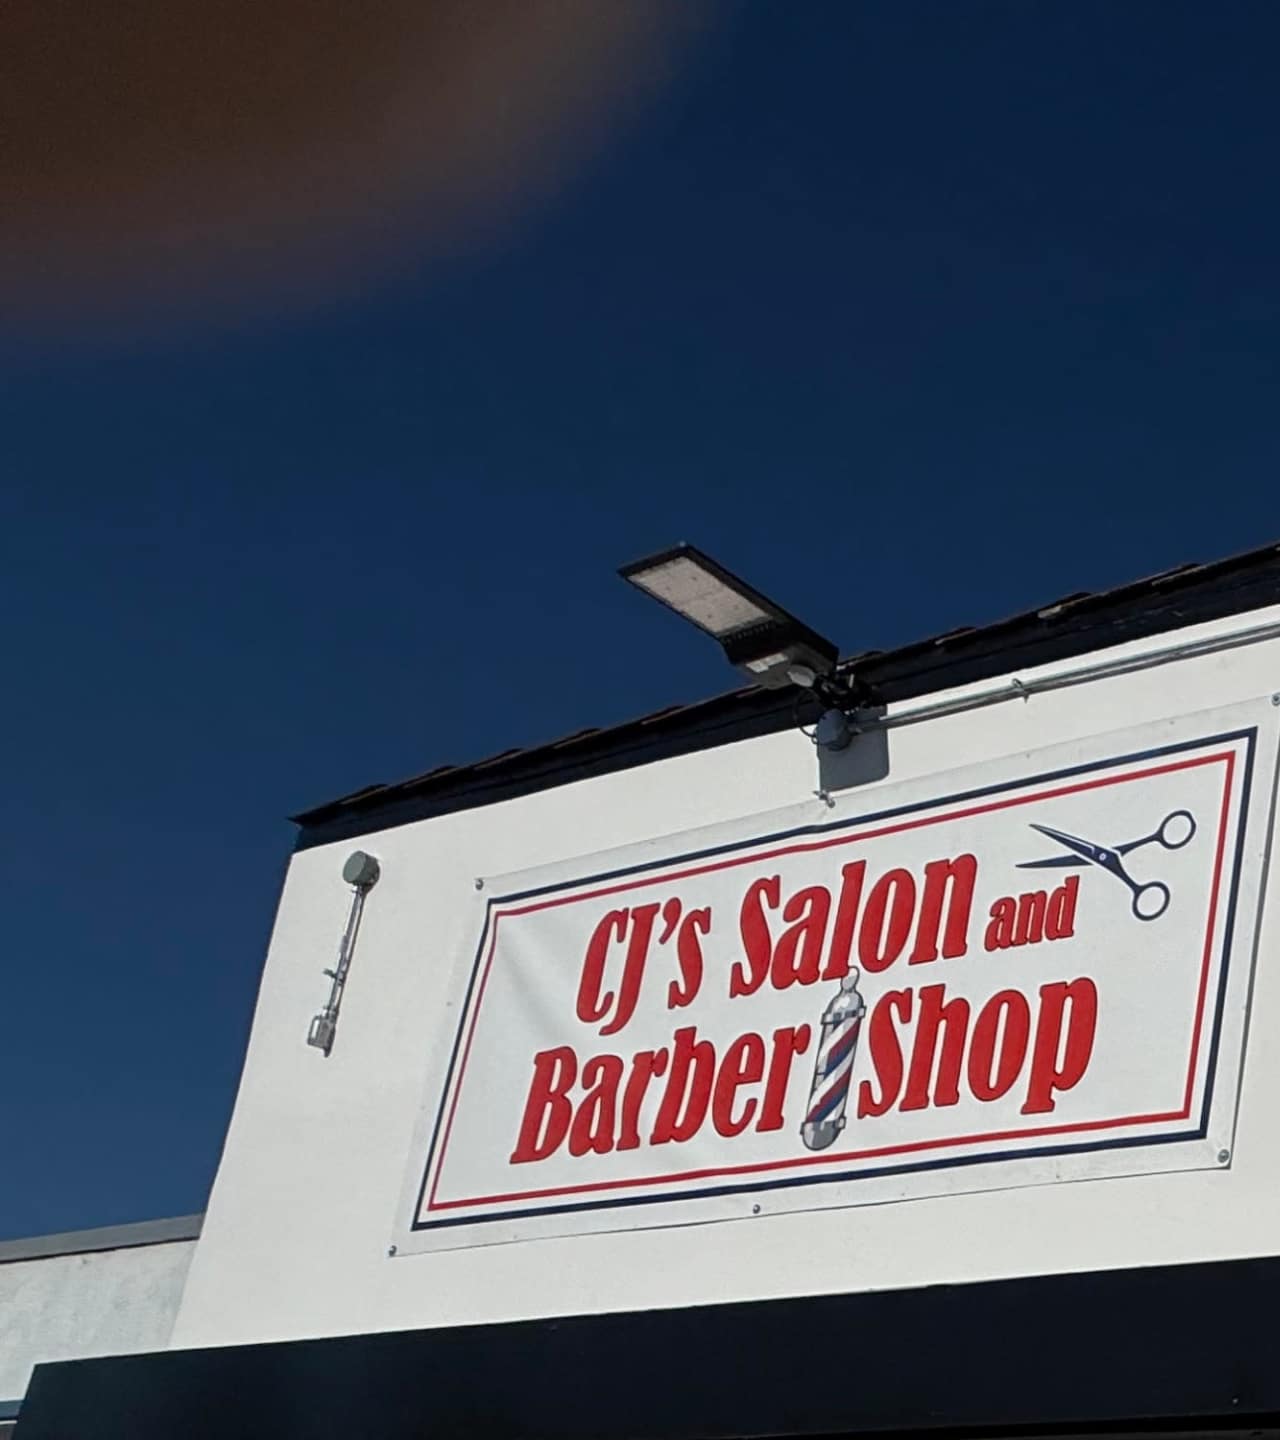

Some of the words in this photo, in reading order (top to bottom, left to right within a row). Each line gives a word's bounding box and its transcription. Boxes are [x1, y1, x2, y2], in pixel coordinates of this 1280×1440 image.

[575, 896, 712, 1037] CJ's
[729, 852, 979, 1001] Salon
[984, 874, 1081, 950] and
[509, 1023, 812, 1165] Barber
[858, 976, 1099, 1118] Shop
